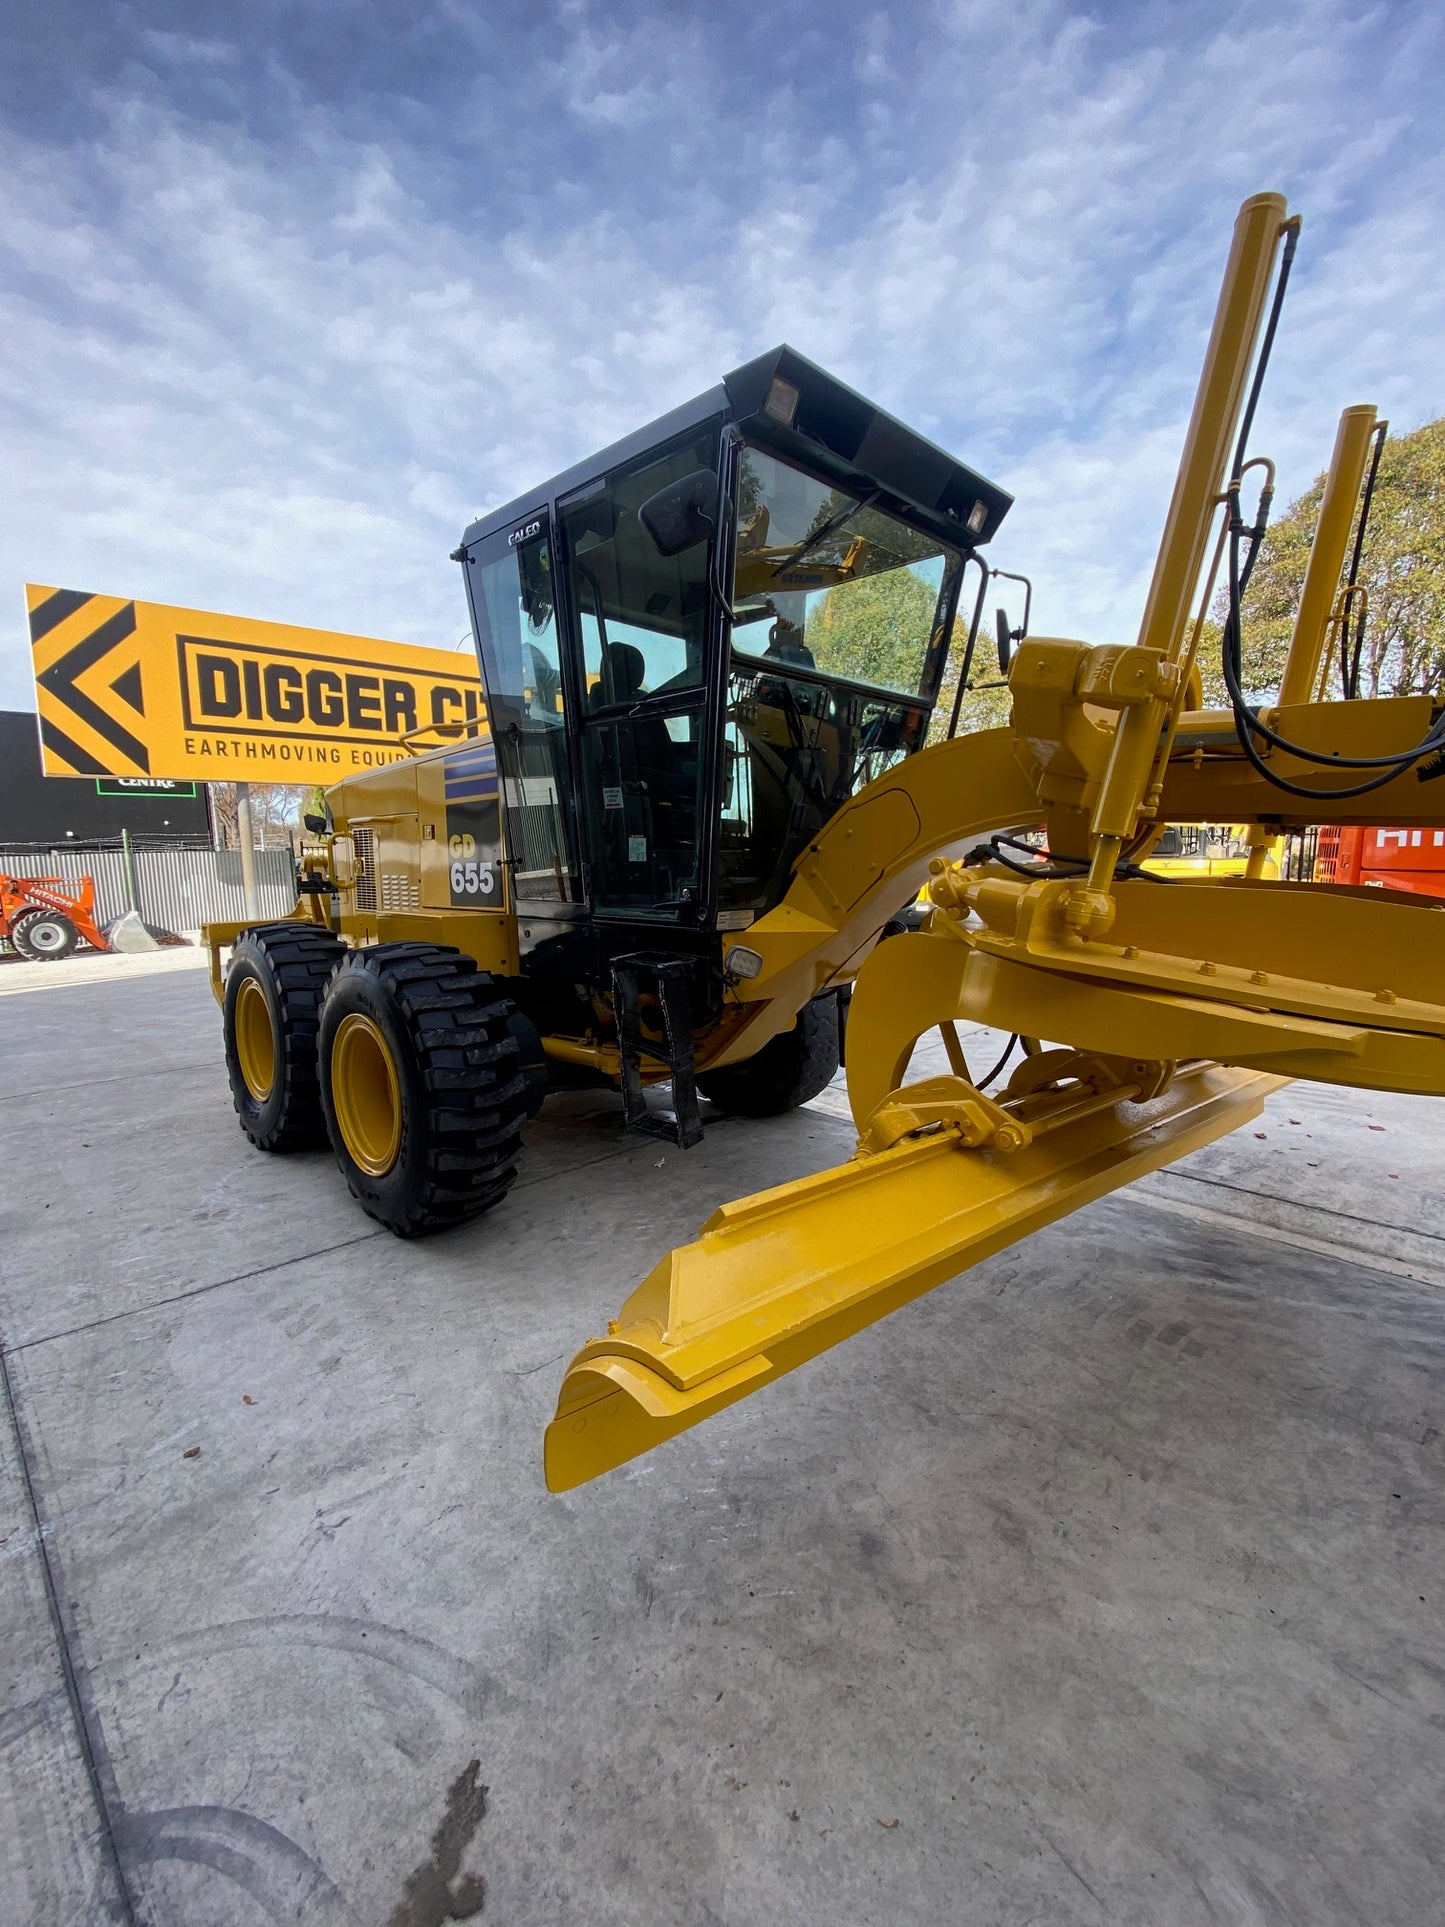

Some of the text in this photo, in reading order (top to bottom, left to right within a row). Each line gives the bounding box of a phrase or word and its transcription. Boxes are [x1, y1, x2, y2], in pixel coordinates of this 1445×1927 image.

[196, 653, 486, 740] DIGGER CI
[184, 737, 412, 767] EARTHMOVING EQUI
[449, 833, 476, 859] GD
[450, 862, 494, 894] 655
[29, 886, 75, 909] HITACHI
